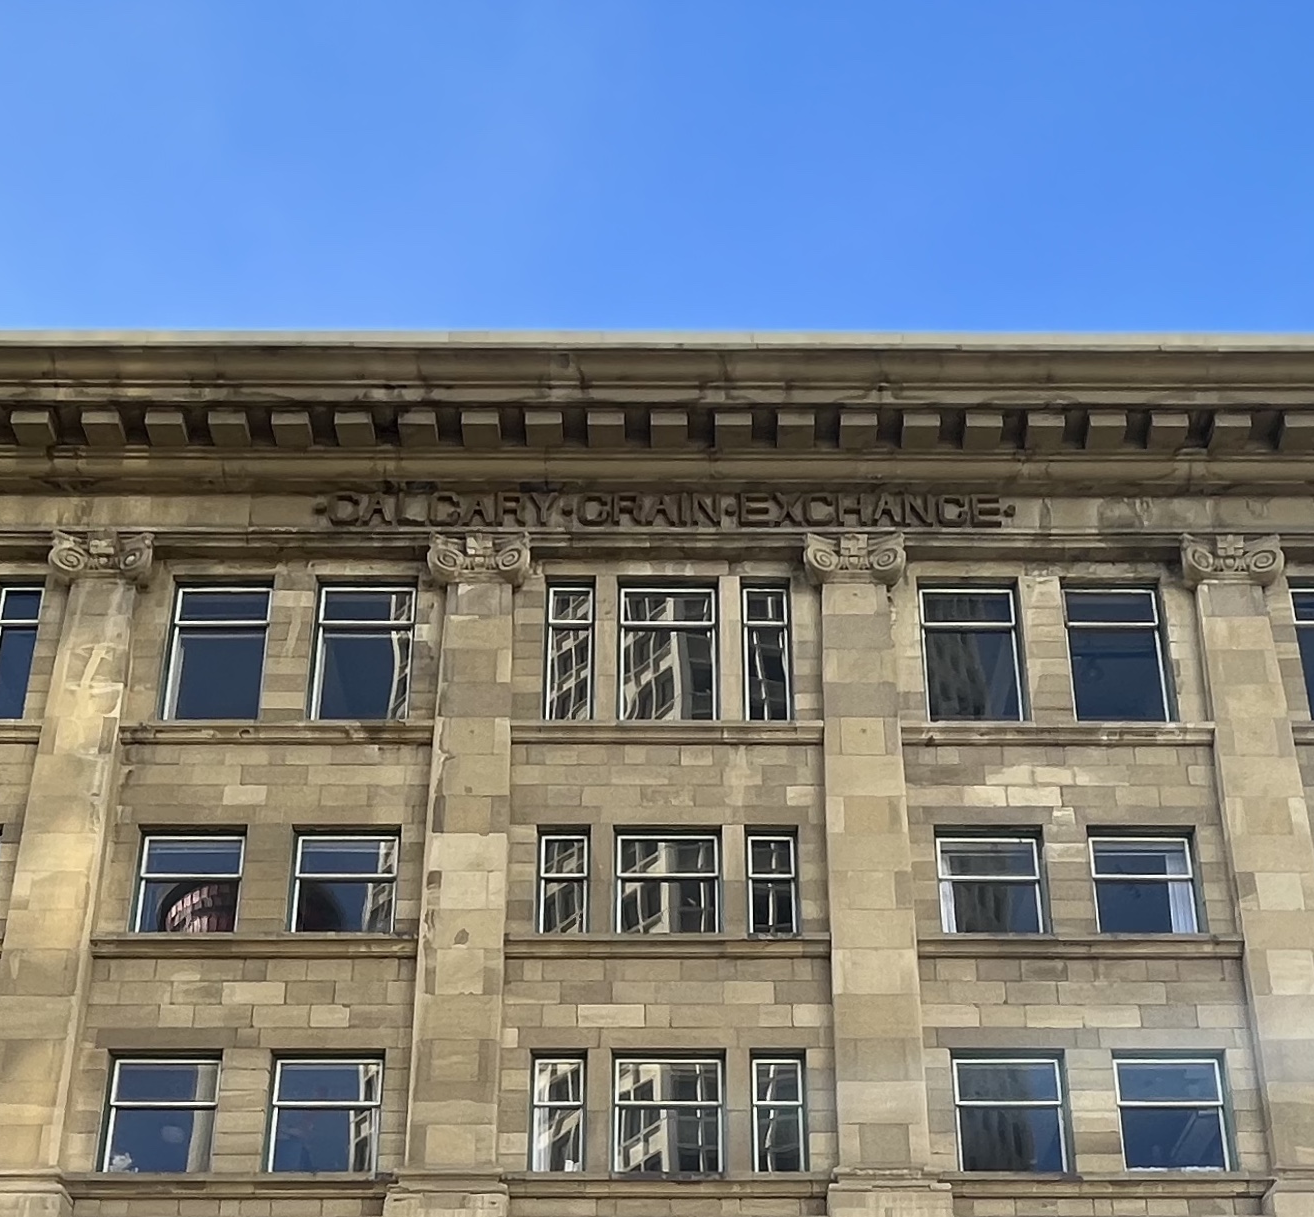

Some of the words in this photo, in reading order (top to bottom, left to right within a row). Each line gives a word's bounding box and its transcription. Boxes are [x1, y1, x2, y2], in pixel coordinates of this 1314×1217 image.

[328, 491, 559, 527] CALGARY
[579, 492, 721, 527] GRAIN
[736, 492, 1002, 528] EXCHANGE
